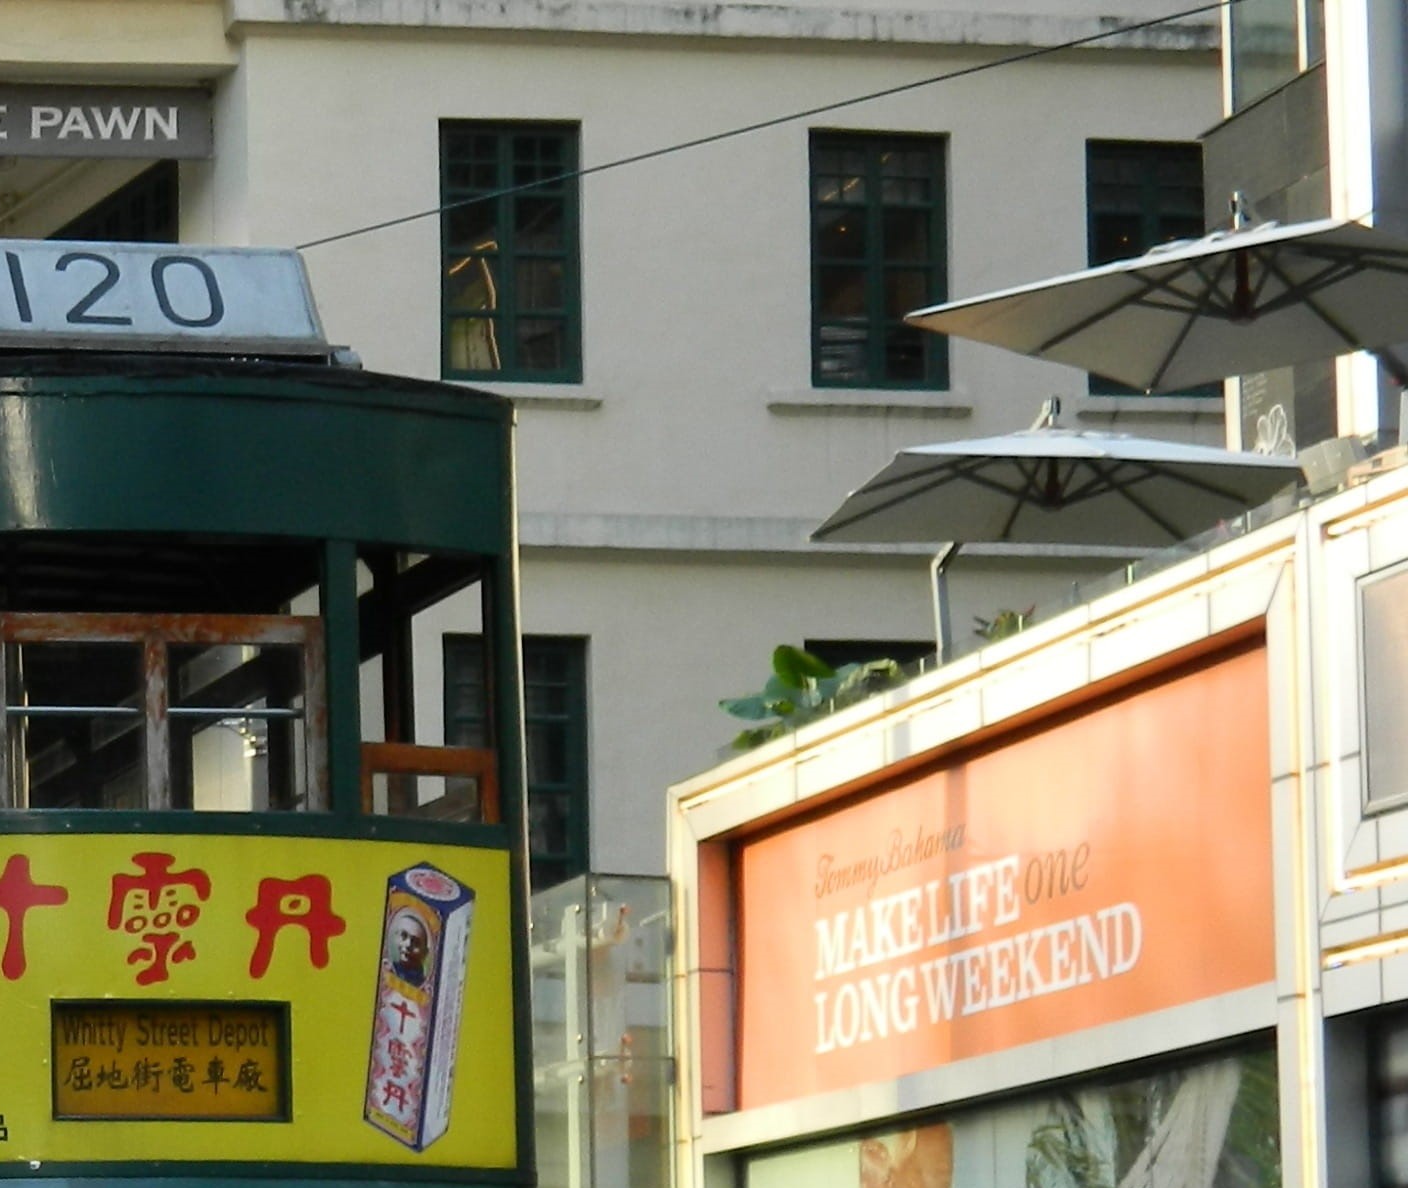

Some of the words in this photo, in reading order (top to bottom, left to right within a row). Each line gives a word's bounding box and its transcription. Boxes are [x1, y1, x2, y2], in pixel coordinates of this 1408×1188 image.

[31, 106, 178, 140] PAWN
[4, 251, 224, 328] 120
[815, 851, 881, 899] Tommy
[880, 823, 967, 876] Bahama
[814, 888, 923, 981] MAKE
[927, 854, 1020, 947] LIFE
[1024, 841, 1091, 905] one
[814, 967, 920, 1055] LONG
[920, 901, 1143, 1025] WEEKEND
[63, 1014, 128, 1053] Whitty
[136, 1014, 201, 1047] Street
[208, 1014, 269, 1052] Depot
[64, 1056, 268, 1096] 屈地街電車廠
